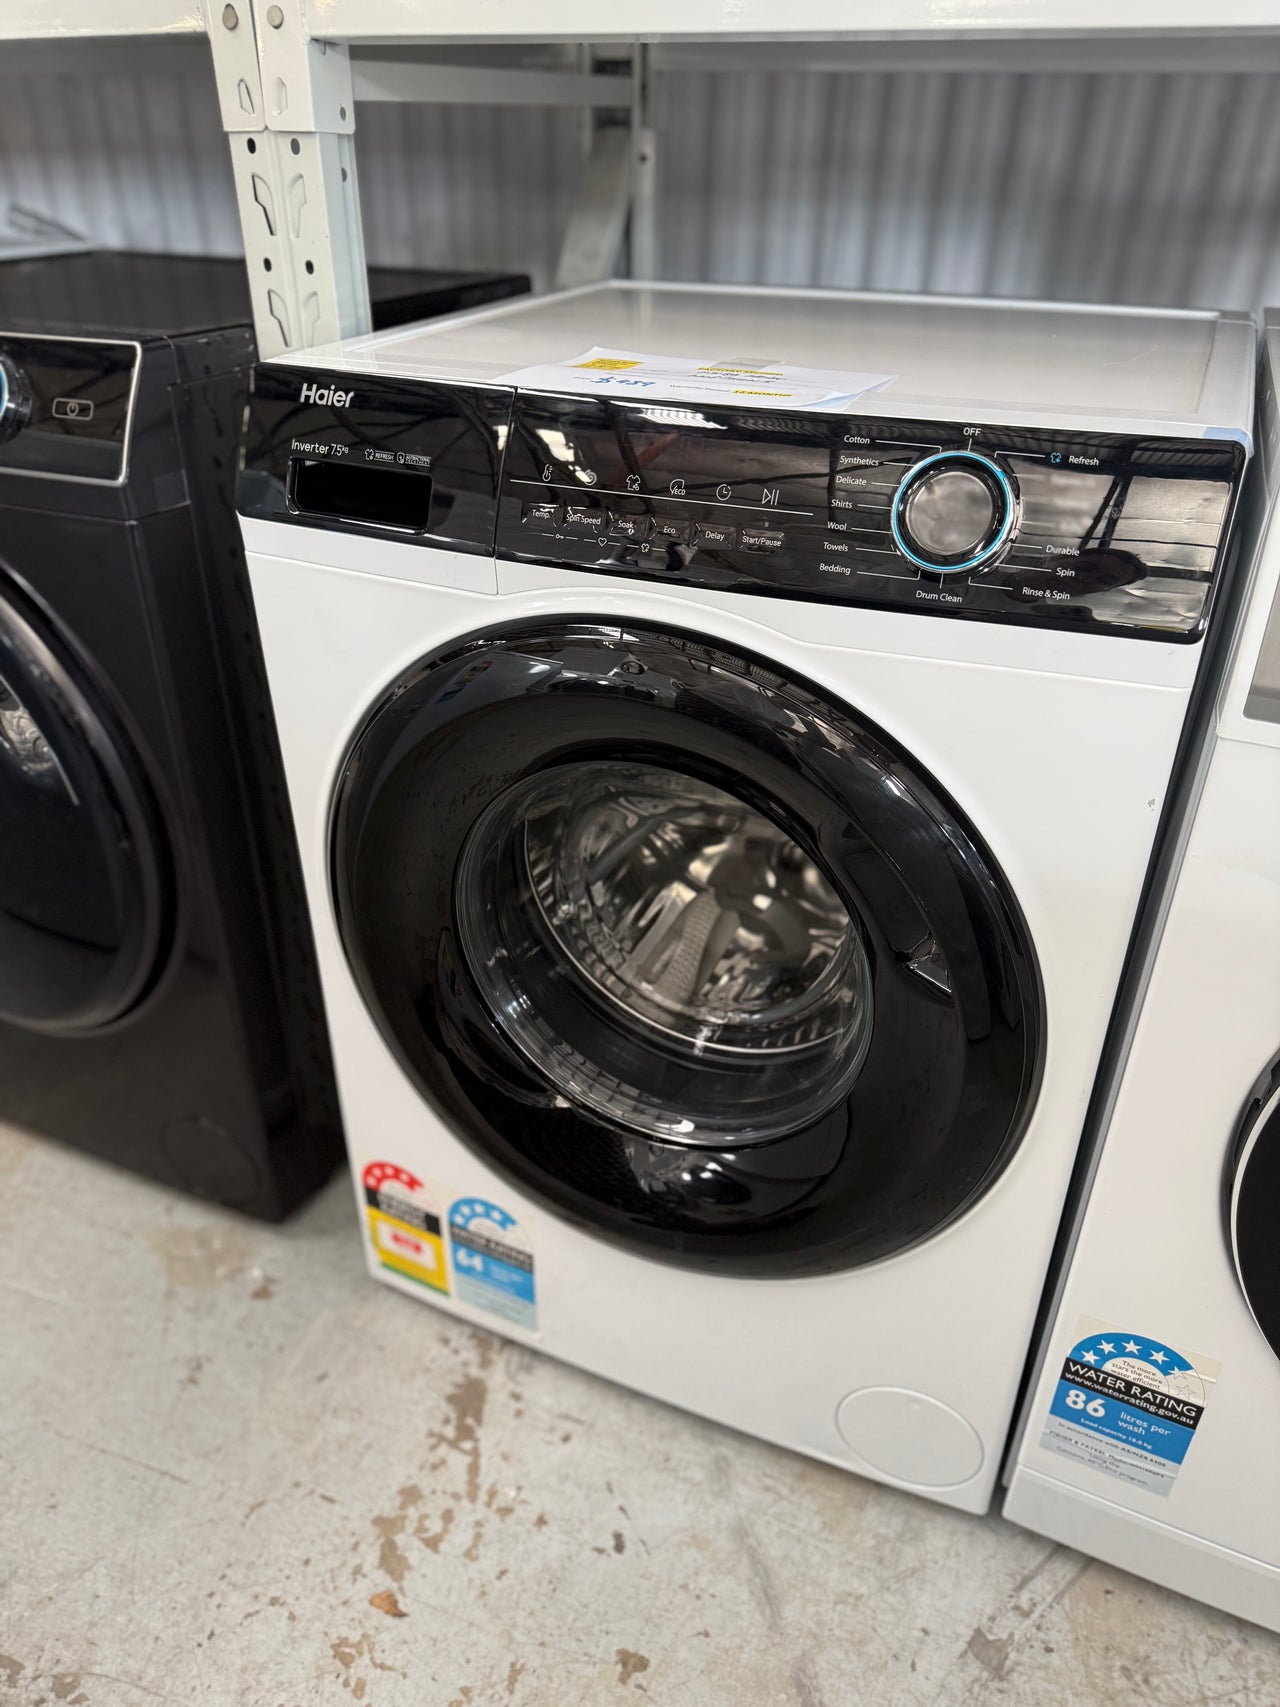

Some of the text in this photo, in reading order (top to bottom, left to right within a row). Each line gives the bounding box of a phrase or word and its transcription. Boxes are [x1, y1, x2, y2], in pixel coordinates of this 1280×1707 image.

[299, 383, 355, 408] Haier
[963, 427, 981, 437] OFF
[843, 434, 870, 445] Cotton
[291, 438, 330, 455] Inverter
[839, 455, 880, 467] Synthetics
[1068, 454, 1099, 466] Refresh
[835, 475, 867, 487] Delicate
[831, 499, 853, 509] Shirts
[532, 509, 551, 519] Temp.
[566, 513, 602, 526] Spin Speed
[618, 520, 634, 530] Soak
[663, 525, 676, 534] Eco
[827, 521, 847, 531] Wool
[705, 530, 725, 542] Delay
[742, 535, 782, 547] Start/Pause
[823, 541, 849, 552] Towels
[1046, 545, 1080, 557] Durable
[819, 563, 851, 577] Bedding
[1056, 567, 1076, 579] Spin
[915, 590, 963, 604] Drum Clean
[1022, 586, 1070, 601] Rinse & Spin
[455, 1248, 484, 1272] 64
[1111, 1363, 1163, 1384] stars the more
[1122, 1359, 1157, 1377] The more
[1068, 1361, 1198, 1417] WATER RATING
[1132, 1375, 1161, 1390] efficient
[1064, 1371, 1195, 1426] www.waterrating.gov.au
[1065, 1388, 1106, 1419] 86
[1081, 1418, 1098, 1429] Load
[1098, 1424, 1127, 1440] capacity
[1118, 1421, 1146, 1436] wash
[1120, 1411, 1171, 1436] litres per
[1104, 1440, 1120, 1449] with
[1121, 1446, 1149, 1461] AS/NZS
[1149, 1458, 1167, 1468] 6400
